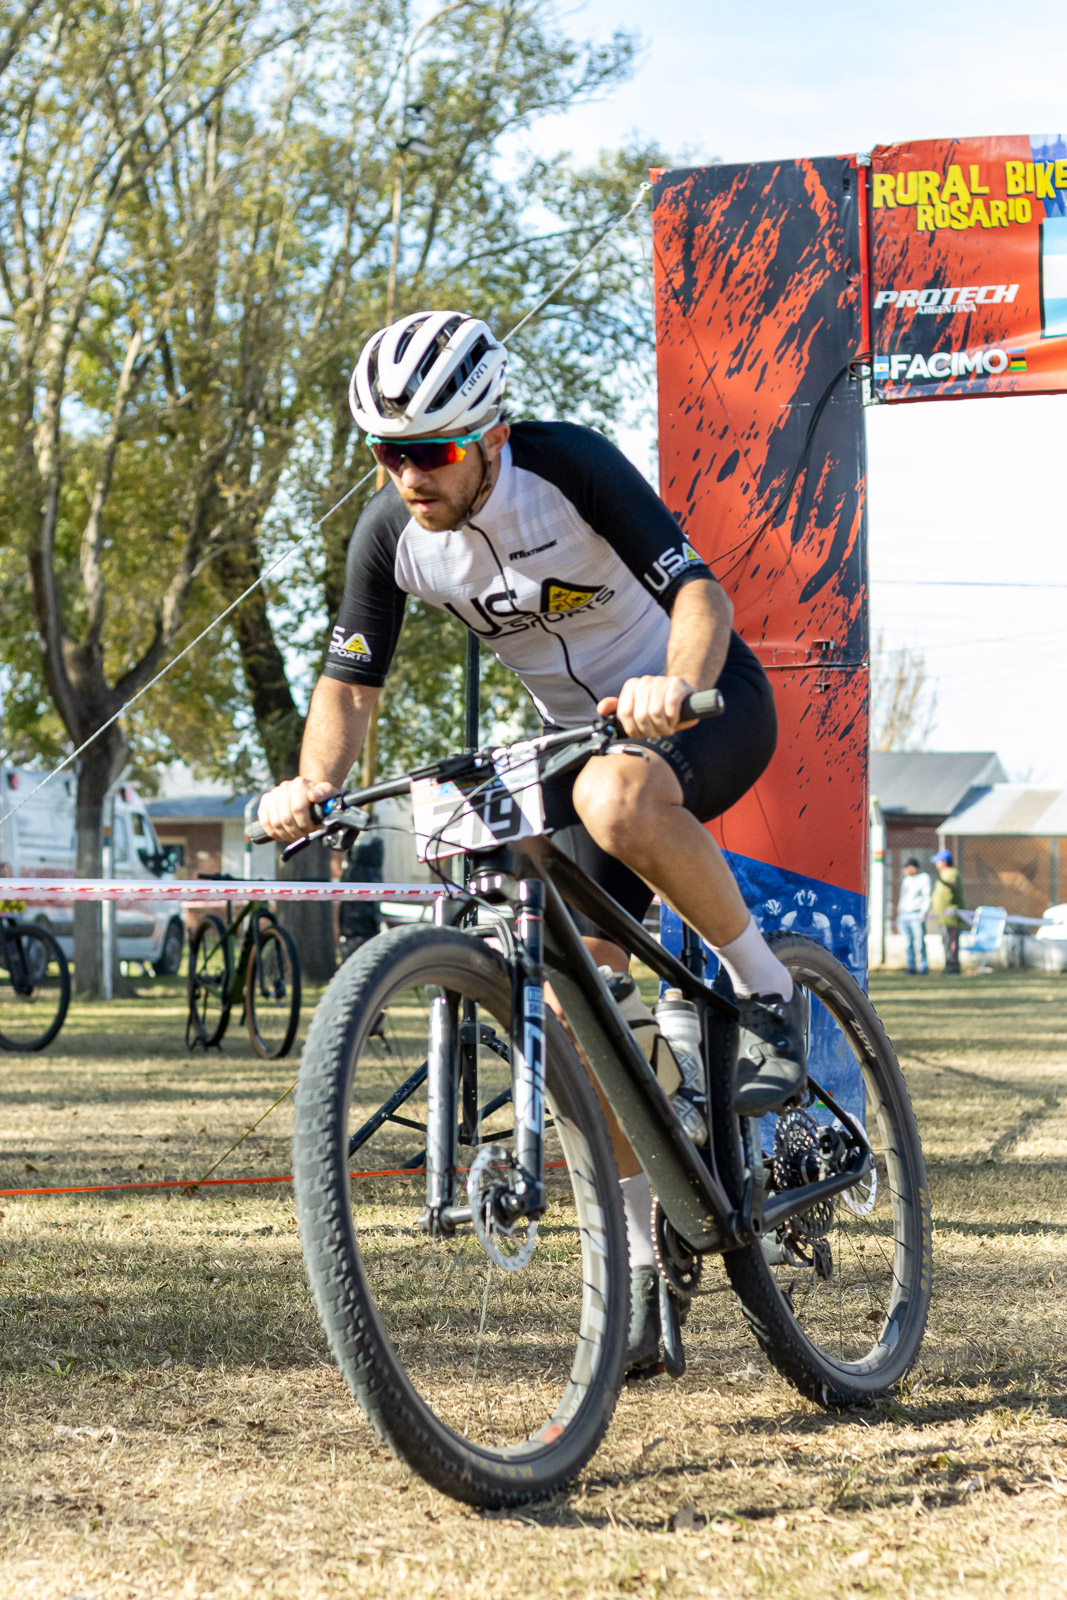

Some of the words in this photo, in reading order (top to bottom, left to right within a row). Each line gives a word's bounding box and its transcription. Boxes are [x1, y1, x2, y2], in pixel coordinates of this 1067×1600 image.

[872, 164, 990, 209] RURAL
[916, 197, 1032, 232] ROSARIO
[873, 284, 1020, 309] PROTECH
[914, 303, 977, 315] ARGENTINA
[461, 363, 488, 397] GIRO
[890, 348, 1009, 380] FACIMO
[643, 541, 704, 592] USA
[849, 1018, 877, 1058] ZIPP
